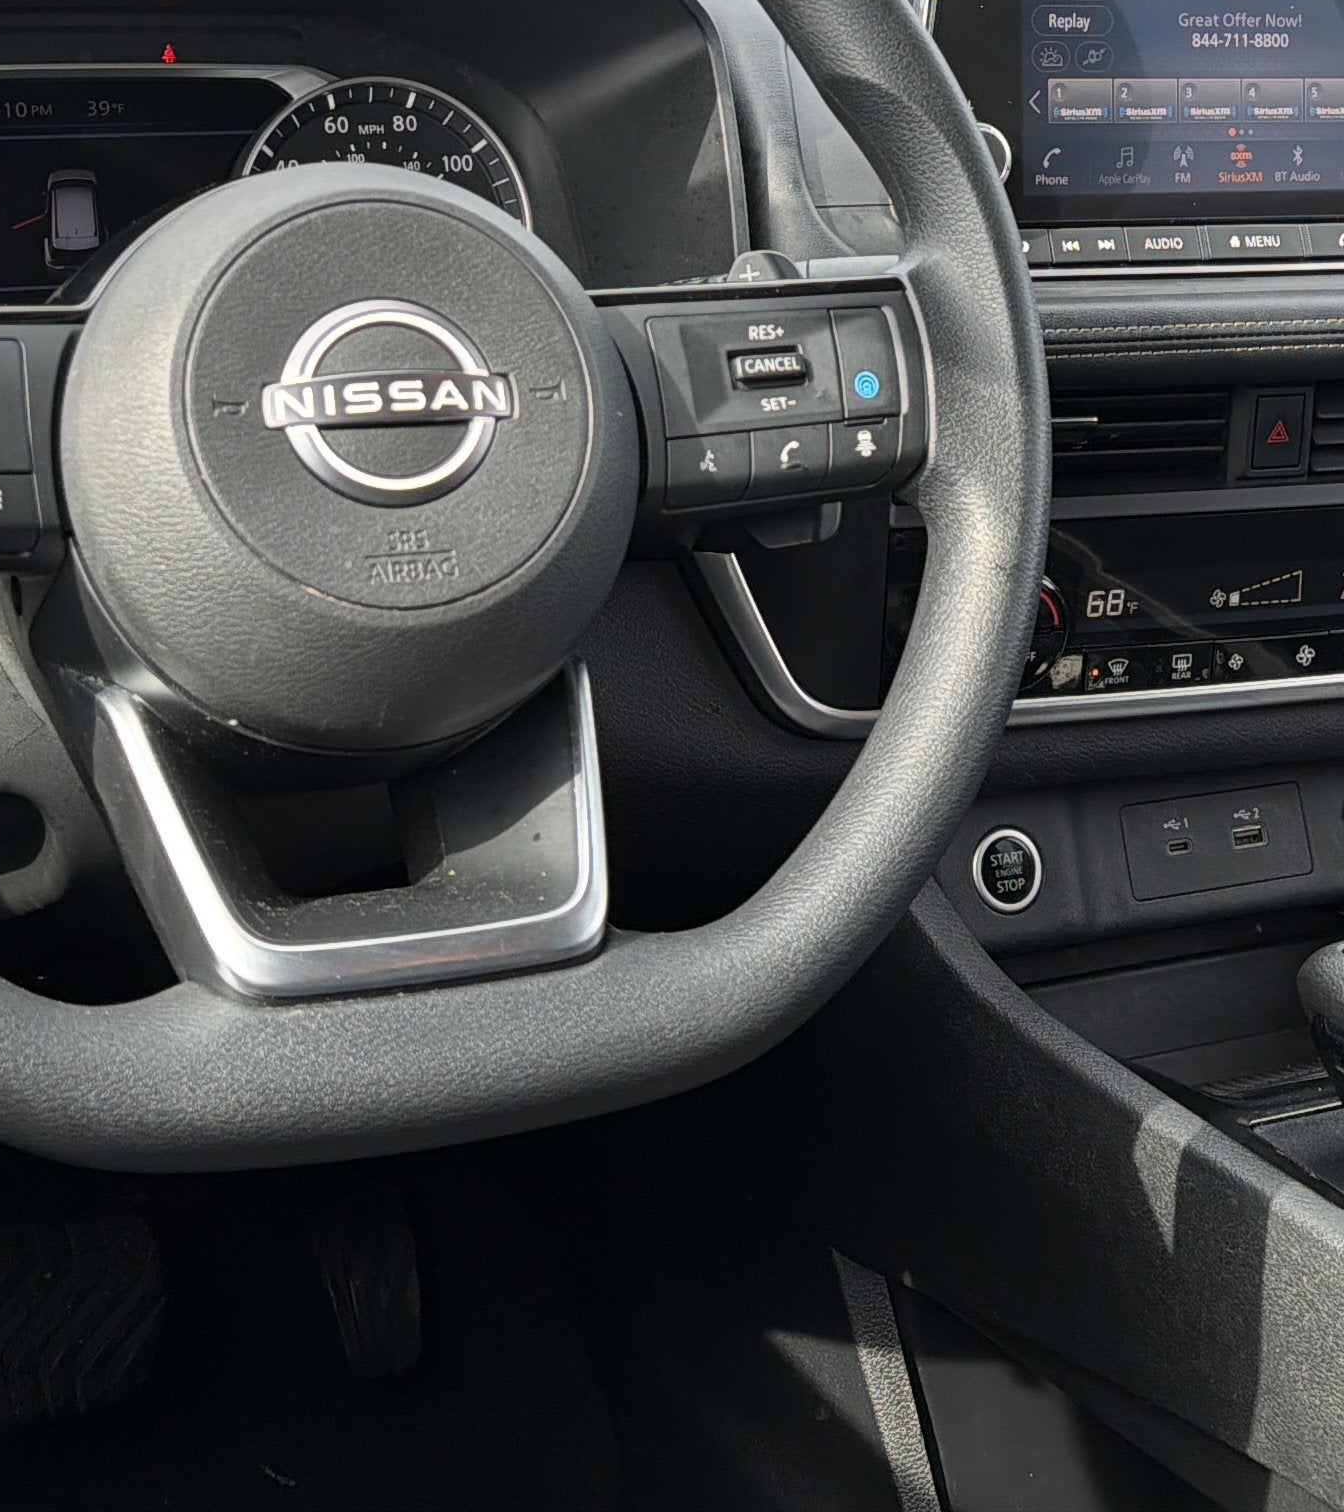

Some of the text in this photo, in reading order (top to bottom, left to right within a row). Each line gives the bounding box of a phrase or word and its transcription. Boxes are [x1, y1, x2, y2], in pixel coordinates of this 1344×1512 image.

[1048, 13, 1091, 32] Replay
[1178, 13, 1303, 28] Great Offer Now!
[1191, 33, 1289, 48] 844-711-8800
[1056, 88, 1062, 98] 1
[1120, 87, 1128, 99] 2
[1185, 87, 1193, 99] 3
[1248, 87, 1256, 98] 4
[1311, 87, 1318, 98] 5
[31, 104, 52, 116] PM
[324, 115, 349, 134] 60
[358, 123, 385, 135] MPH
[392, 114, 417, 133] 80
[347, 153, 366, 164] 100
[441, 154, 474, 173] 100
[1035, 174, 1069, 186] Phone
[1098, 173, 1152, 185] Apple CarPlay
[1174, 173, 1191, 183] FM
[1218, 172, 1264, 184] SiriusXM
[1274, 171, 1321, 182] BT Audio
[1144, 236, 1184, 251] AUDIO
[1245, 234, 1281, 249] MENU
[748, 324, 785, 341] RES+
[743, 355, 801, 375] CANCEL
[273, 379, 508, 421] NISSAN
[386, 529, 430, 551] SRS
[369, 557, 460, 586] AIRBAG
[1104, 675, 1130, 685] FRONT
[1171, 671, 1192, 680] REAR
[1252, 807, 1260, 819] 2
[1183, 817, 1189, 829] 1
[989, 850, 1024, 867] START
[995, 866, 1023, 878] ENGINE
[996, 877, 1026, 894] STOP
